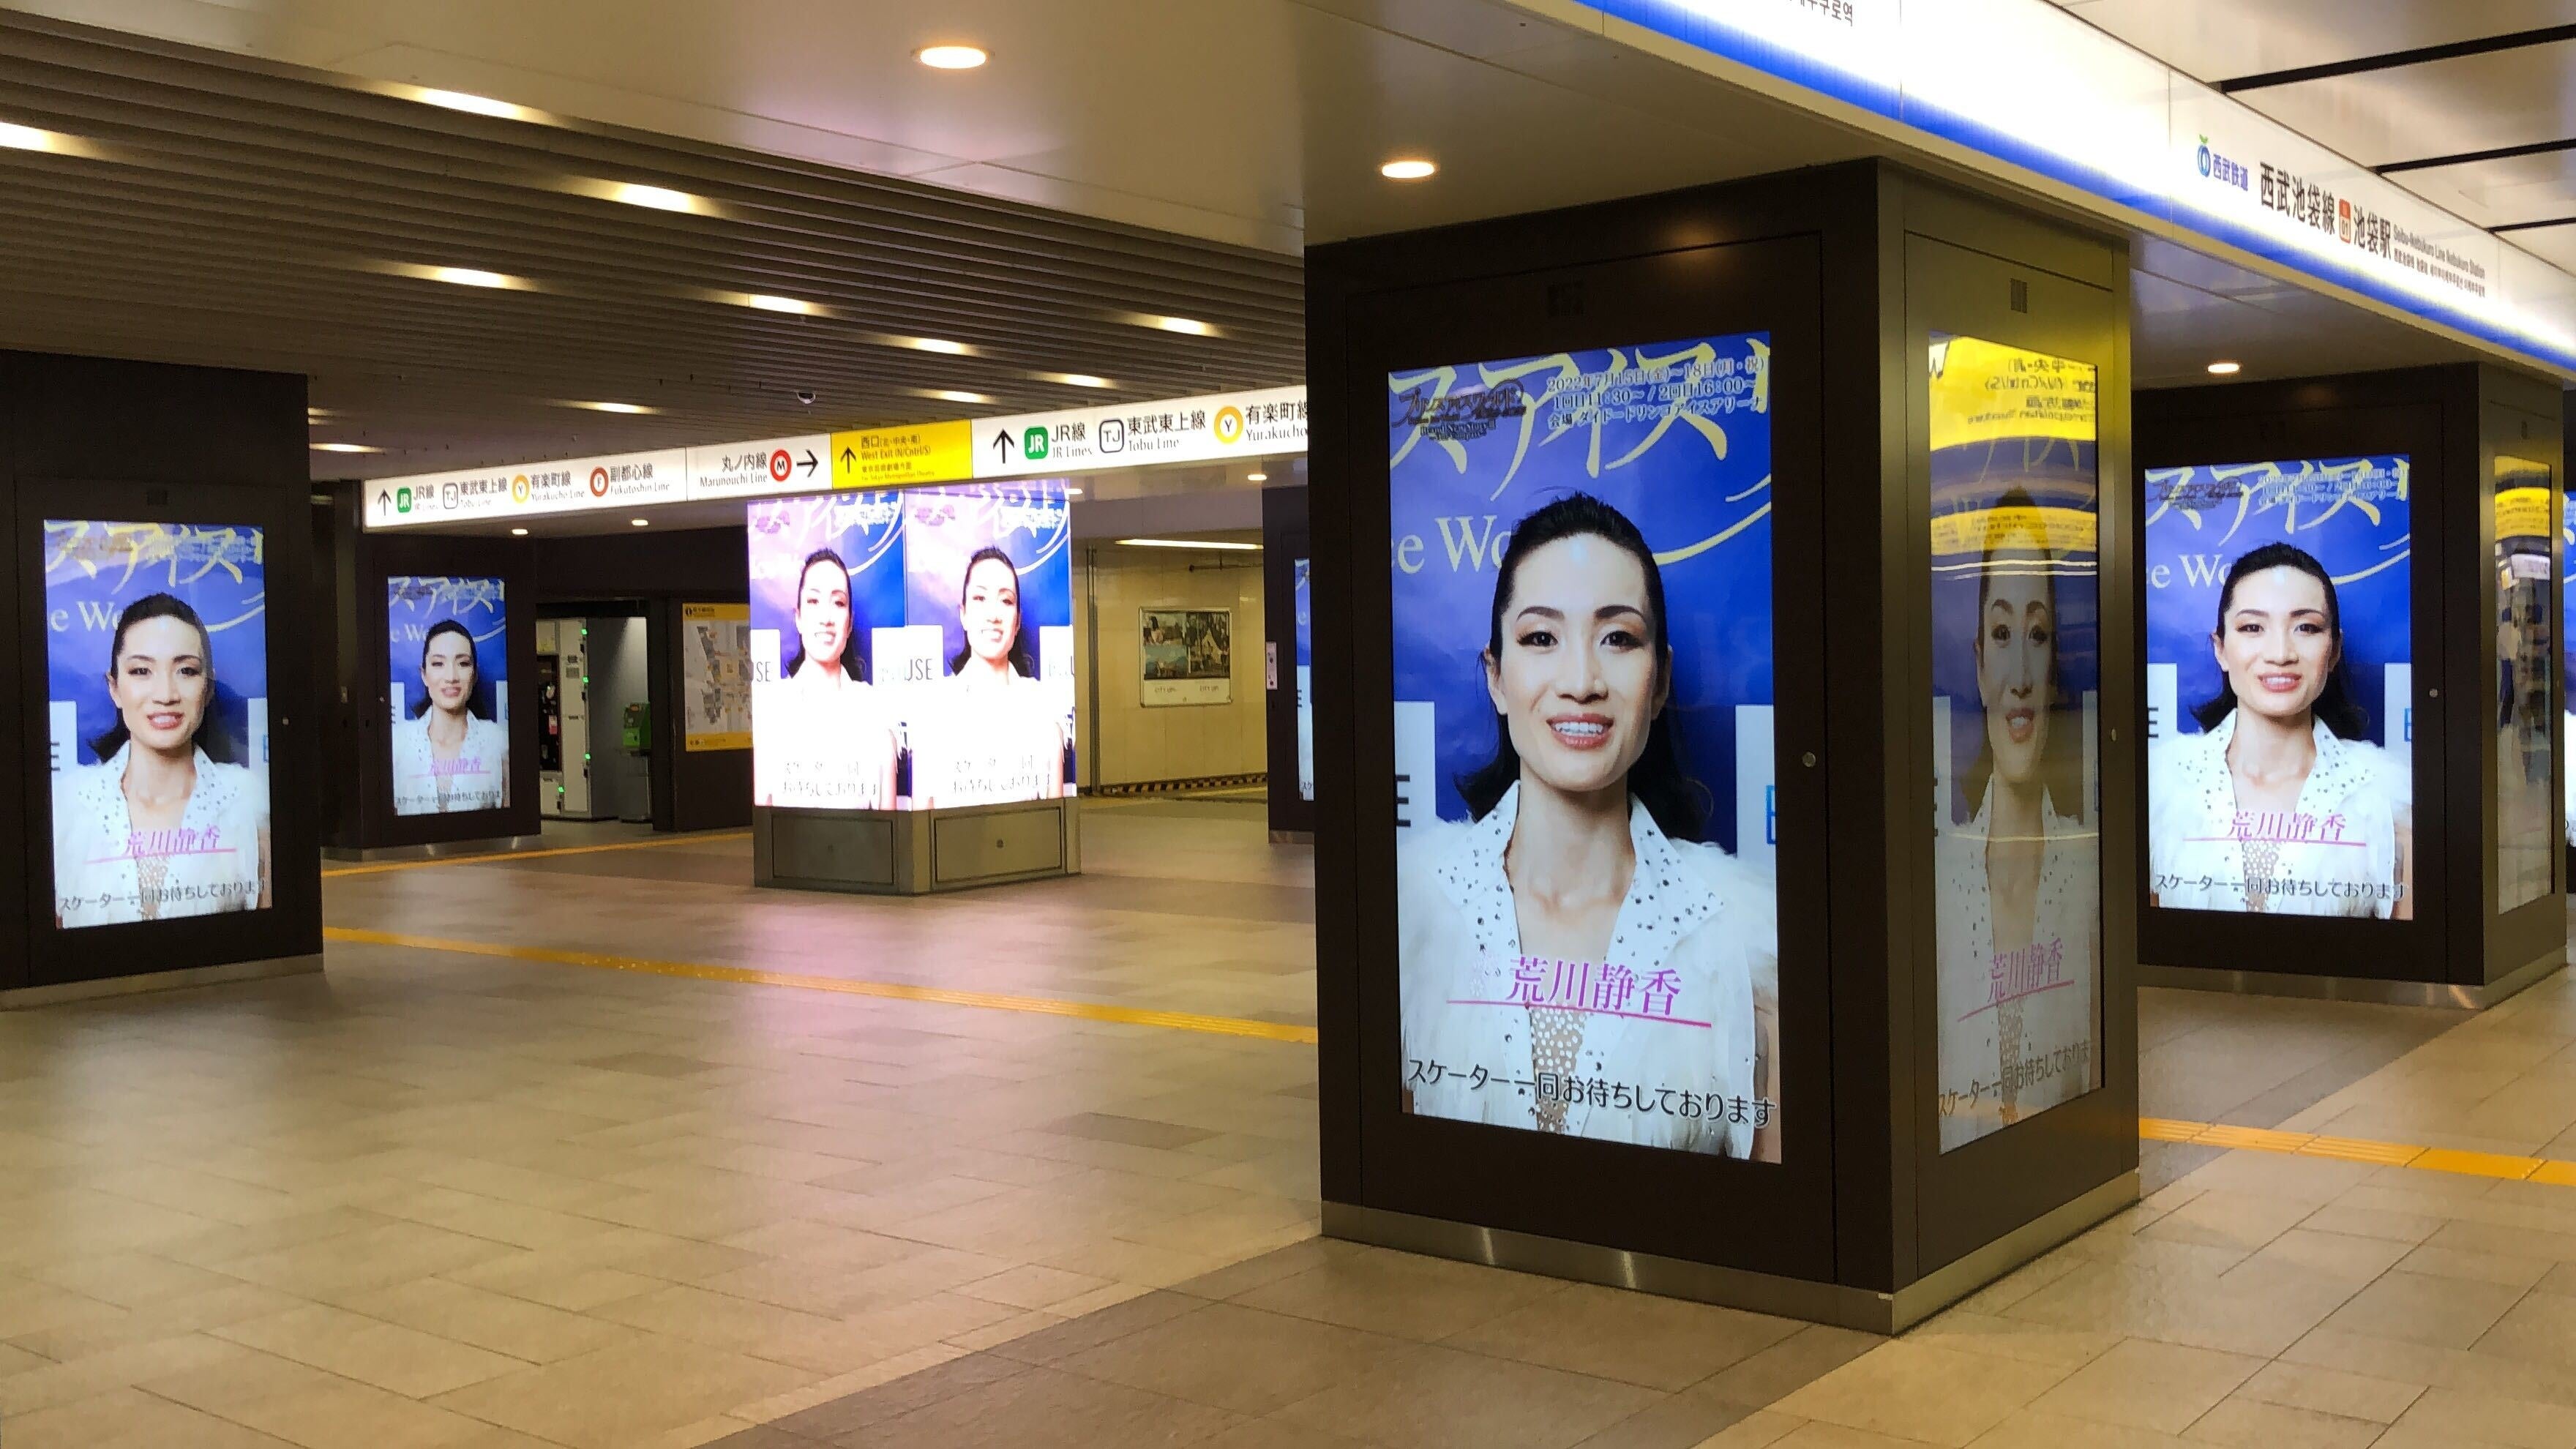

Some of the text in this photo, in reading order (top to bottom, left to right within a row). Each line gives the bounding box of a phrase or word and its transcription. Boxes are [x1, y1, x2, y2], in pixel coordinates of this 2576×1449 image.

[2260, 162, 2335, 235] 西武池袋線
[2354, 204, 2392, 261] 池袋駅
[1052, 422, 1086, 442] JR線
[1127, 409, 1206, 436] 東武東上線
[1224, 418, 1232, 433] Y
[1028, 433, 1044, 454] JR
[1103, 429, 1120, 444] TJ
[610, 462, 654, 483] 副都心線
[722, 452, 767, 473] 丸ノ内線
[776, 456, 786, 471] M
[460, 476, 507, 496] 東武東上線
[531, 470, 572, 490] 有楽町線
[700, 473, 768, 488] Marunouchi Line
[400, 493, 410, 509] JR
[1391, 534, 1425, 574] e
[2228, 811, 2345, 842] 荒川静香
[1988, 937, 2063, 1003] 荒川静香
[1505, 956, 1682, 1016] 荒川静香
[1407, 1060, 1777, 1127] スケーター一同お待ちしております
